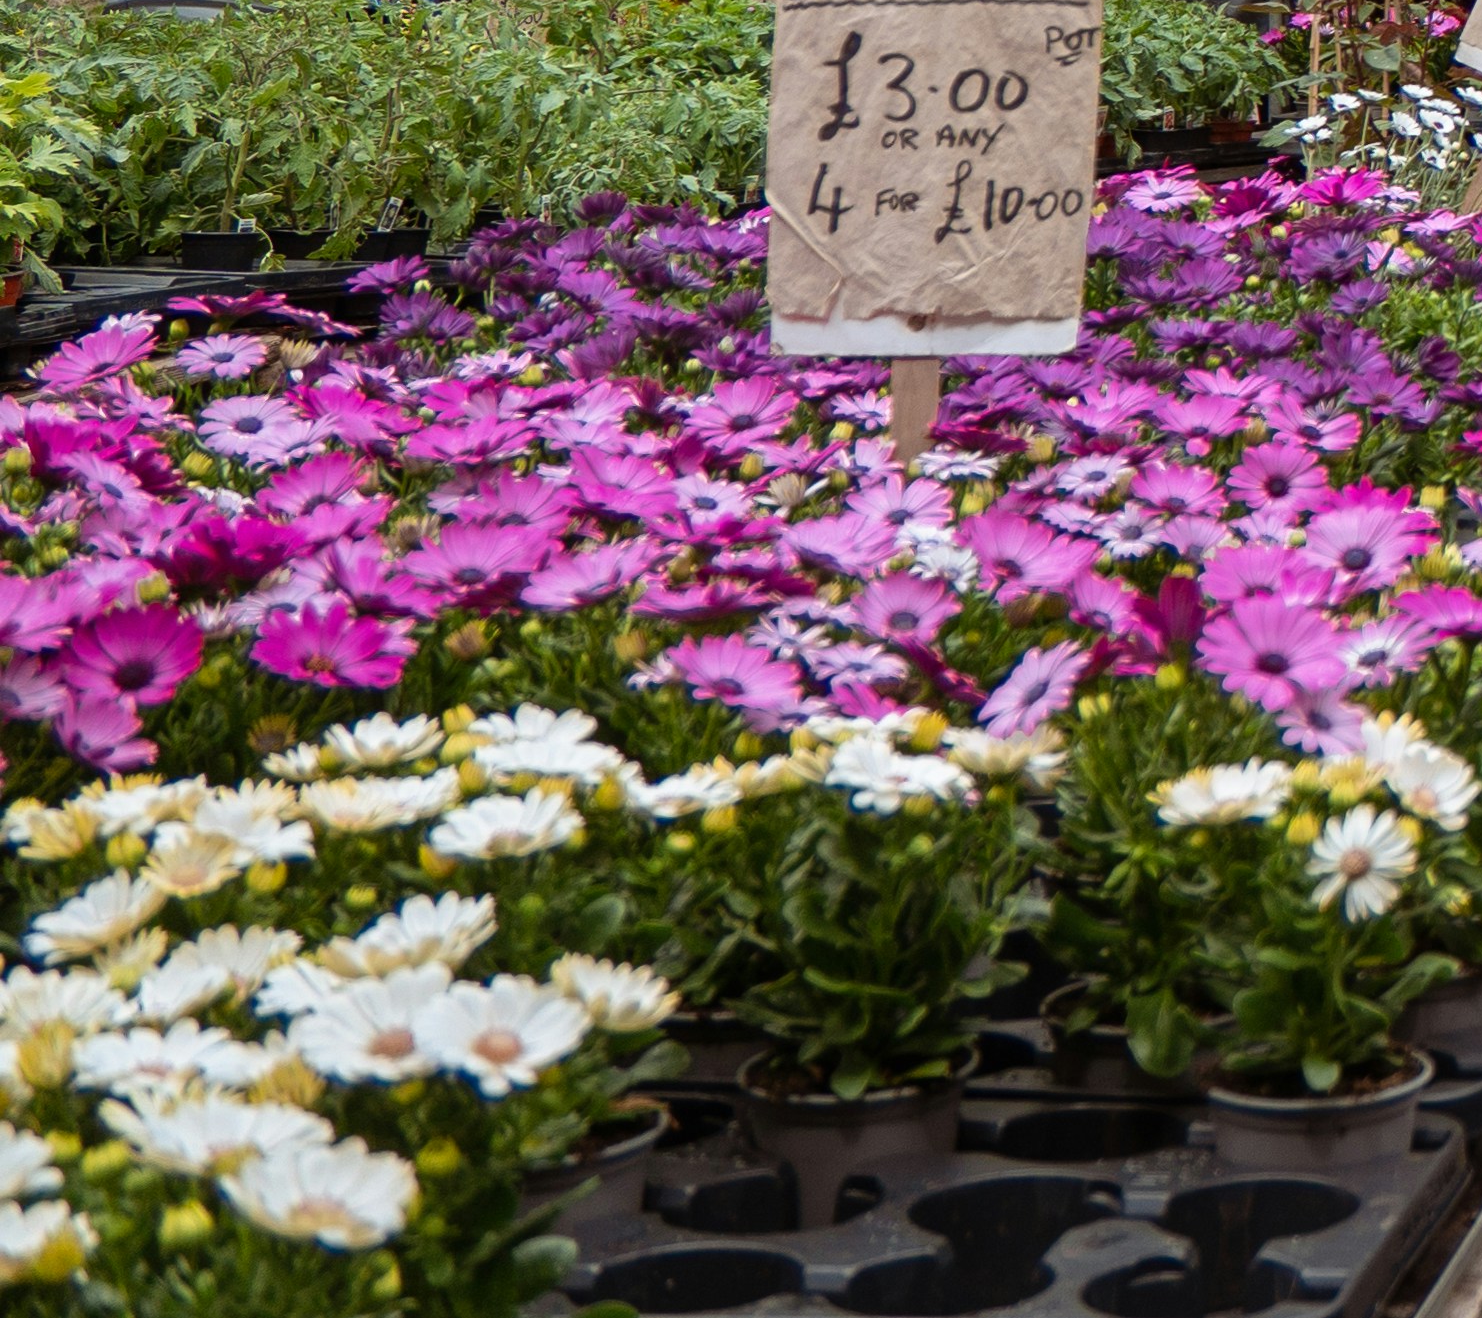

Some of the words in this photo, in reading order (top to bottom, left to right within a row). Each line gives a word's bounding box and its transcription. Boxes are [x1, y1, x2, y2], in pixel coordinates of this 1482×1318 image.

[1044, 25, 1100, 55] POT
[817, 30, 1029, 143] £3.00
[880, 129, 920, 150] OR
[935, 122, 1005, 155] ANY
[807, 163, 855, 235] 4
[874, 188, 920, 214] FOR
[934, 159, 1084, 245] £10.00
